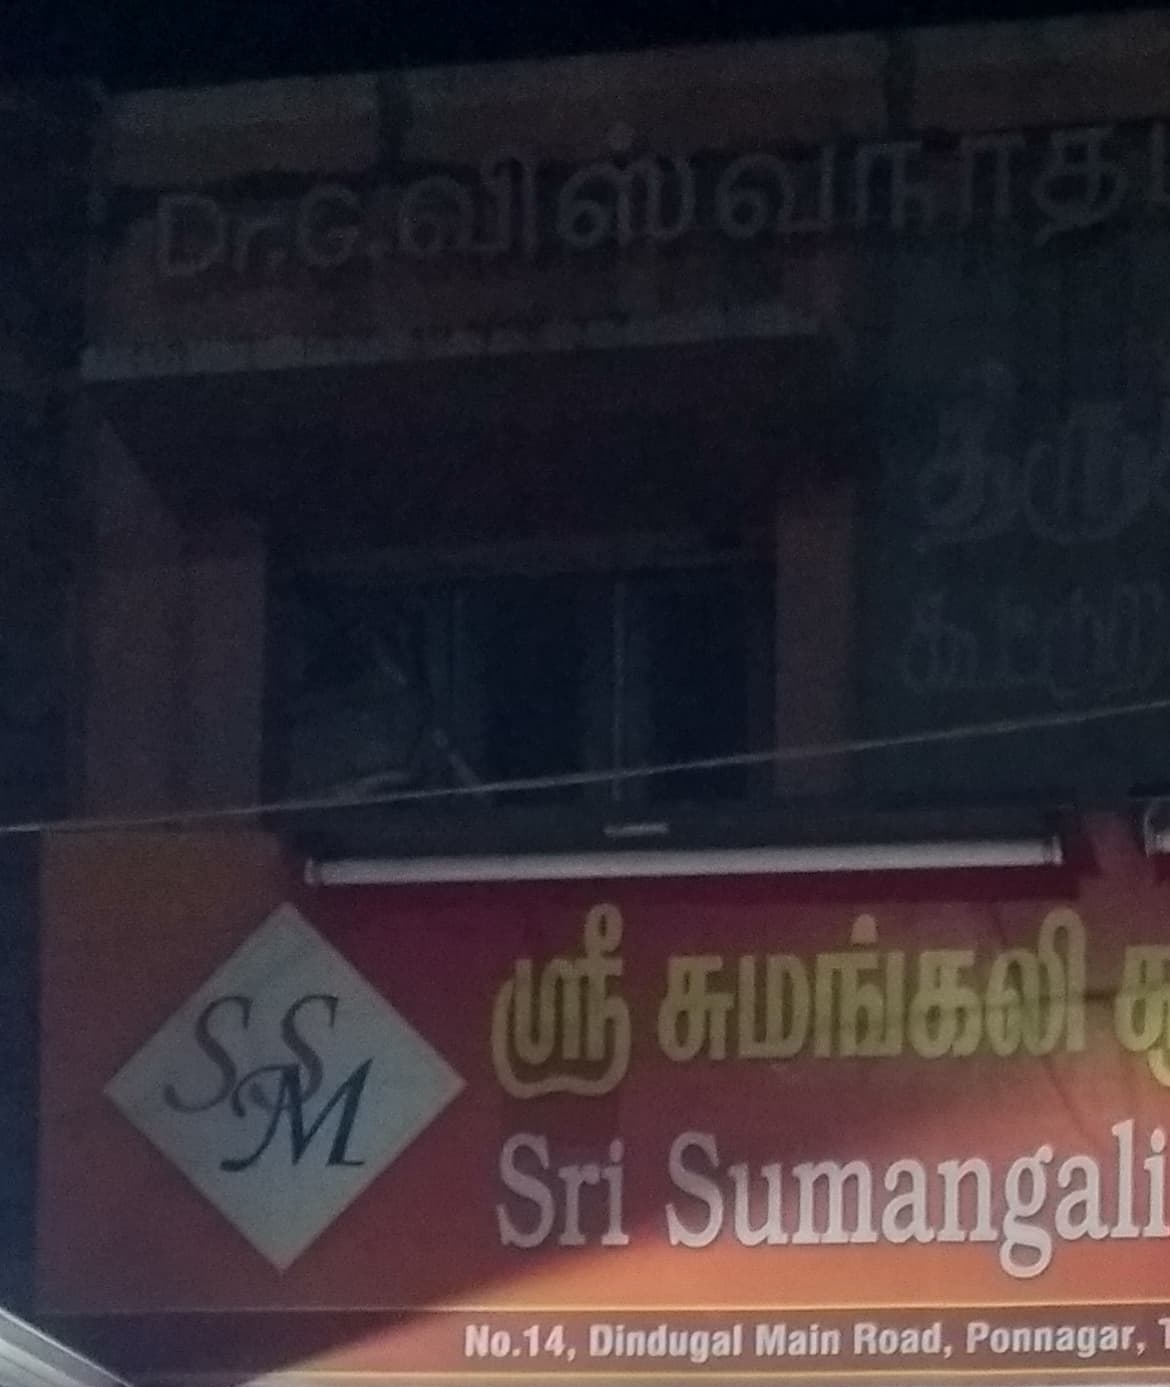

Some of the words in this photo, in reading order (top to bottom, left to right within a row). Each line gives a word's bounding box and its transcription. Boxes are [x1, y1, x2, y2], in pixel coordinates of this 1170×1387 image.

[658, 908, 1086, 1061] சுமங்கலி
[497, 1131, 629, 1250] Sri
[463, 1323, 577, 1362] No.14,
[589, 1322, 743, 1364] Dindugal
[755, 1322, 841, 1358] Main
[852, 1319, 954, 1360] Road,
[966, 1320, 1147, 1359] Ponnagar,
